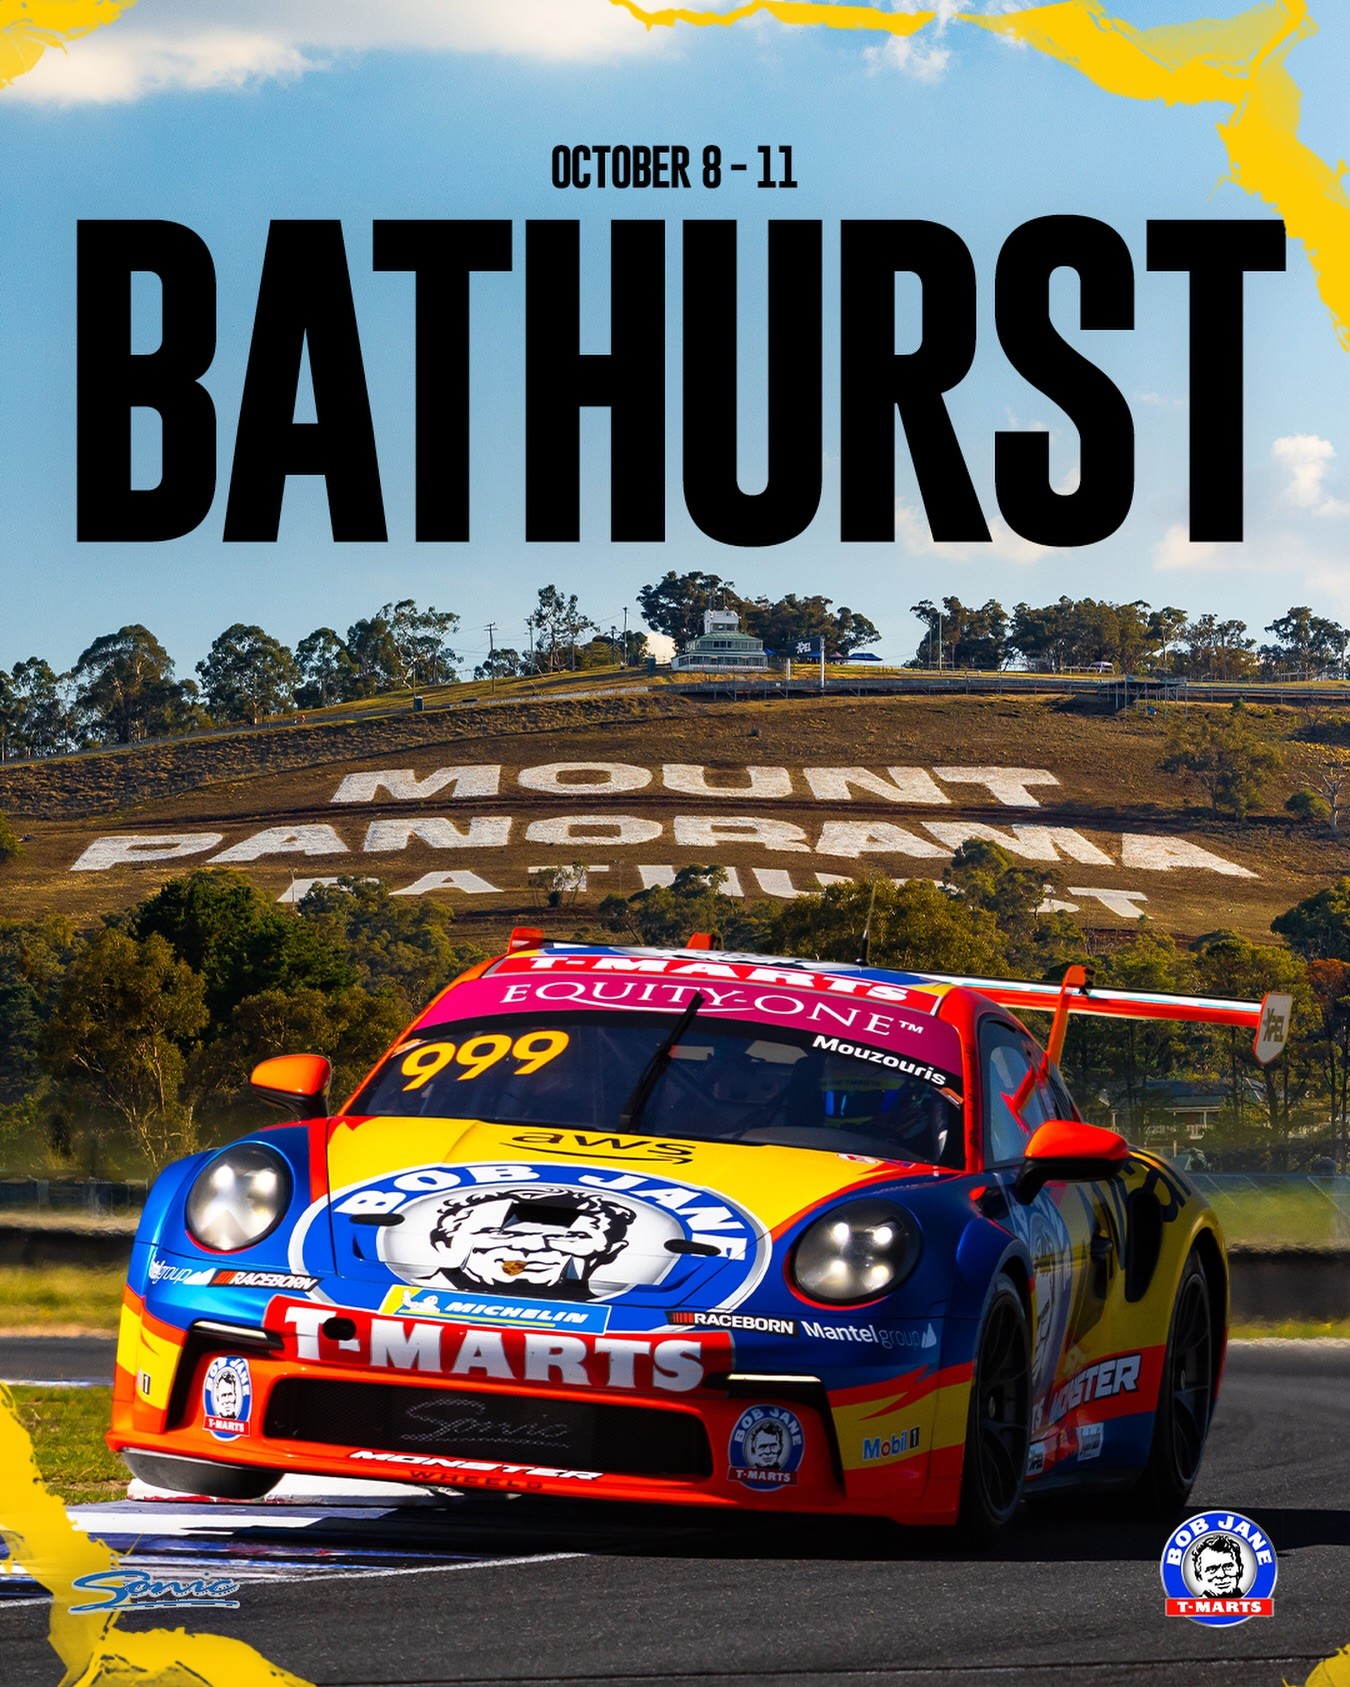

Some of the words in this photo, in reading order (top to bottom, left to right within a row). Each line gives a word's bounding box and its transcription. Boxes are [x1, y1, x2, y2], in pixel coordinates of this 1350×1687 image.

[330, 761, 1060, 809] MOUNT
[69, 815, 1261, 880] PANORAMA
[530, 957, 909, 1001] T-MARTS
[401, 1030, 570, 1092] 999
[812, 1035, 947, 1085] Mouzouris
[510, 1131, 697, 1156] aws
[334, 1164, 540, 1216] BOB
[578, 1174, 747, 1260] JANE
[229, 1271, 317, 1291] RACEBORN
[444, 1299, 590, 1324] MICHELIN
[692, 1312, 794, 1335] RACEBORN
[285, 1305, 704, 1392] T-MARTS
[206, 1357, 228, 1391] BOB
[230, 1358, 250, 1396] JANE
[208, 1417, 245, 1433] T-MARTS
[734, 1407, 764, 1443] BOB
[767, 1405, 802, 1447] JANE
[350, 1449, 604, 1481] MONSTER
[863, 1431, 908, 1460] Mobil
[736, 1469, 791, 1485] T-MARTS
